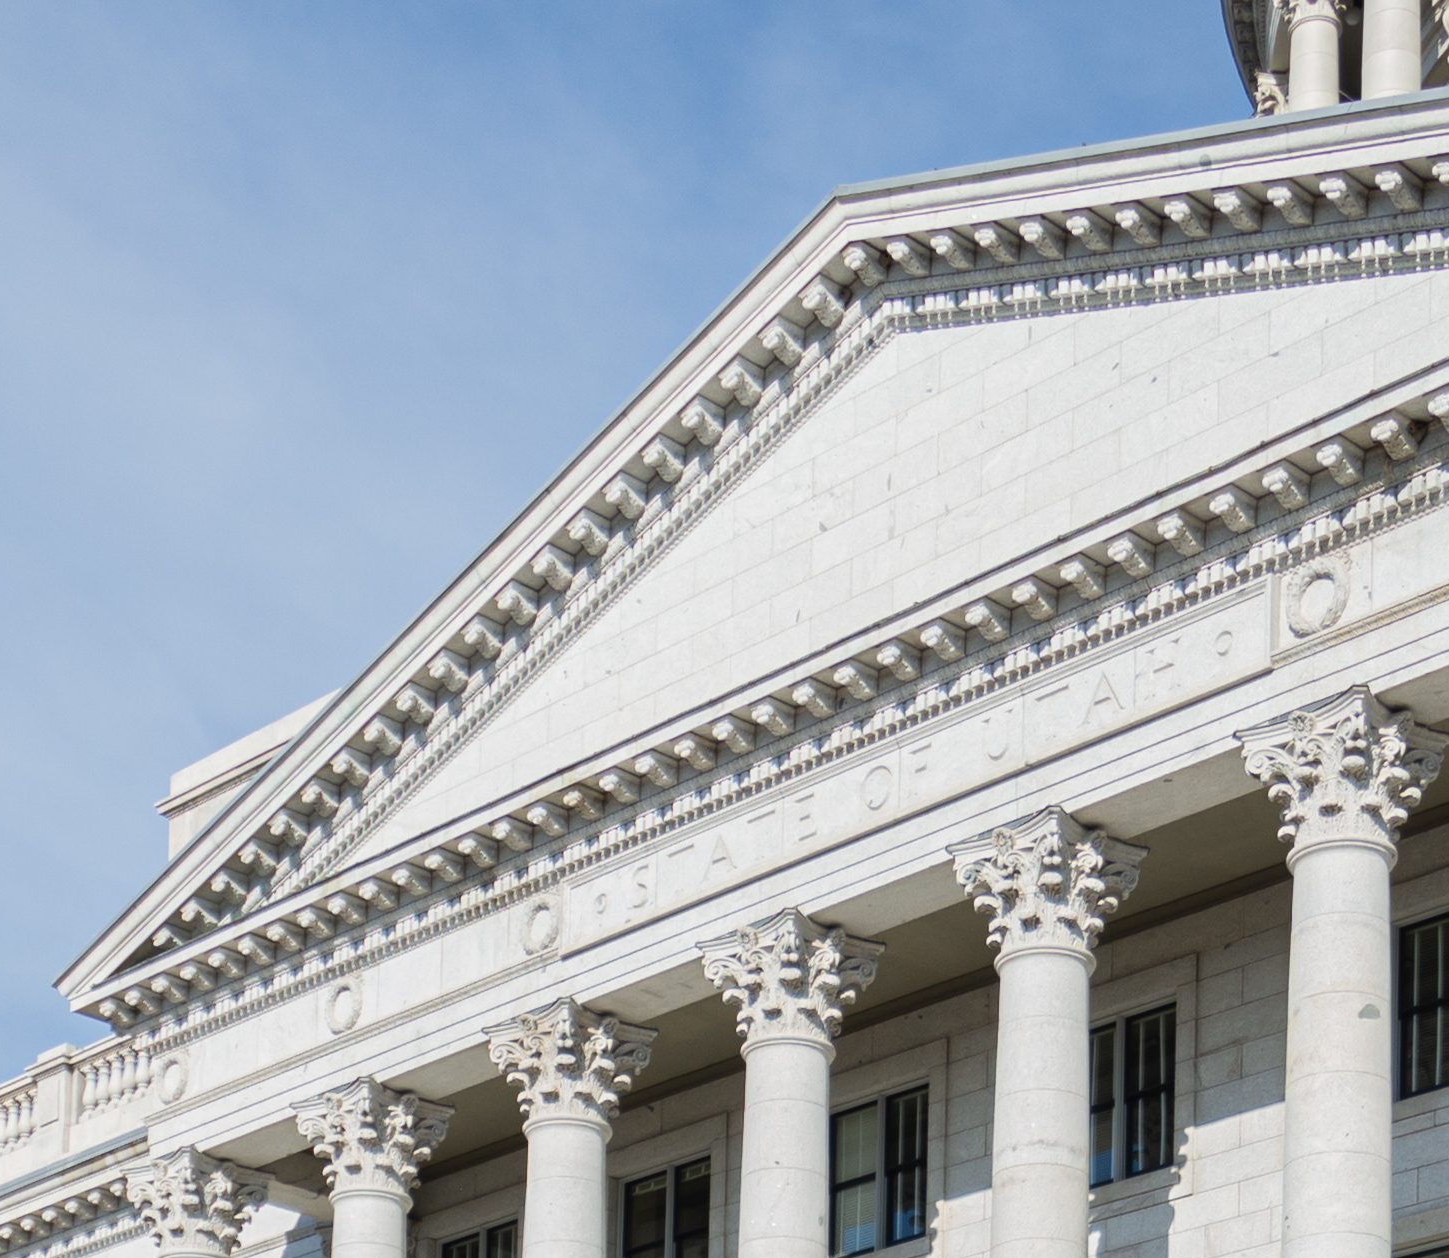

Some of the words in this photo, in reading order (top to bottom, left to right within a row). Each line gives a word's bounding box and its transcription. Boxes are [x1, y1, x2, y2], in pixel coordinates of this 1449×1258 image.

[629, 792, 818, 909] STATE
[860, 742, 933, 811] OF
[981, 636, 1183, 761] UTAH
